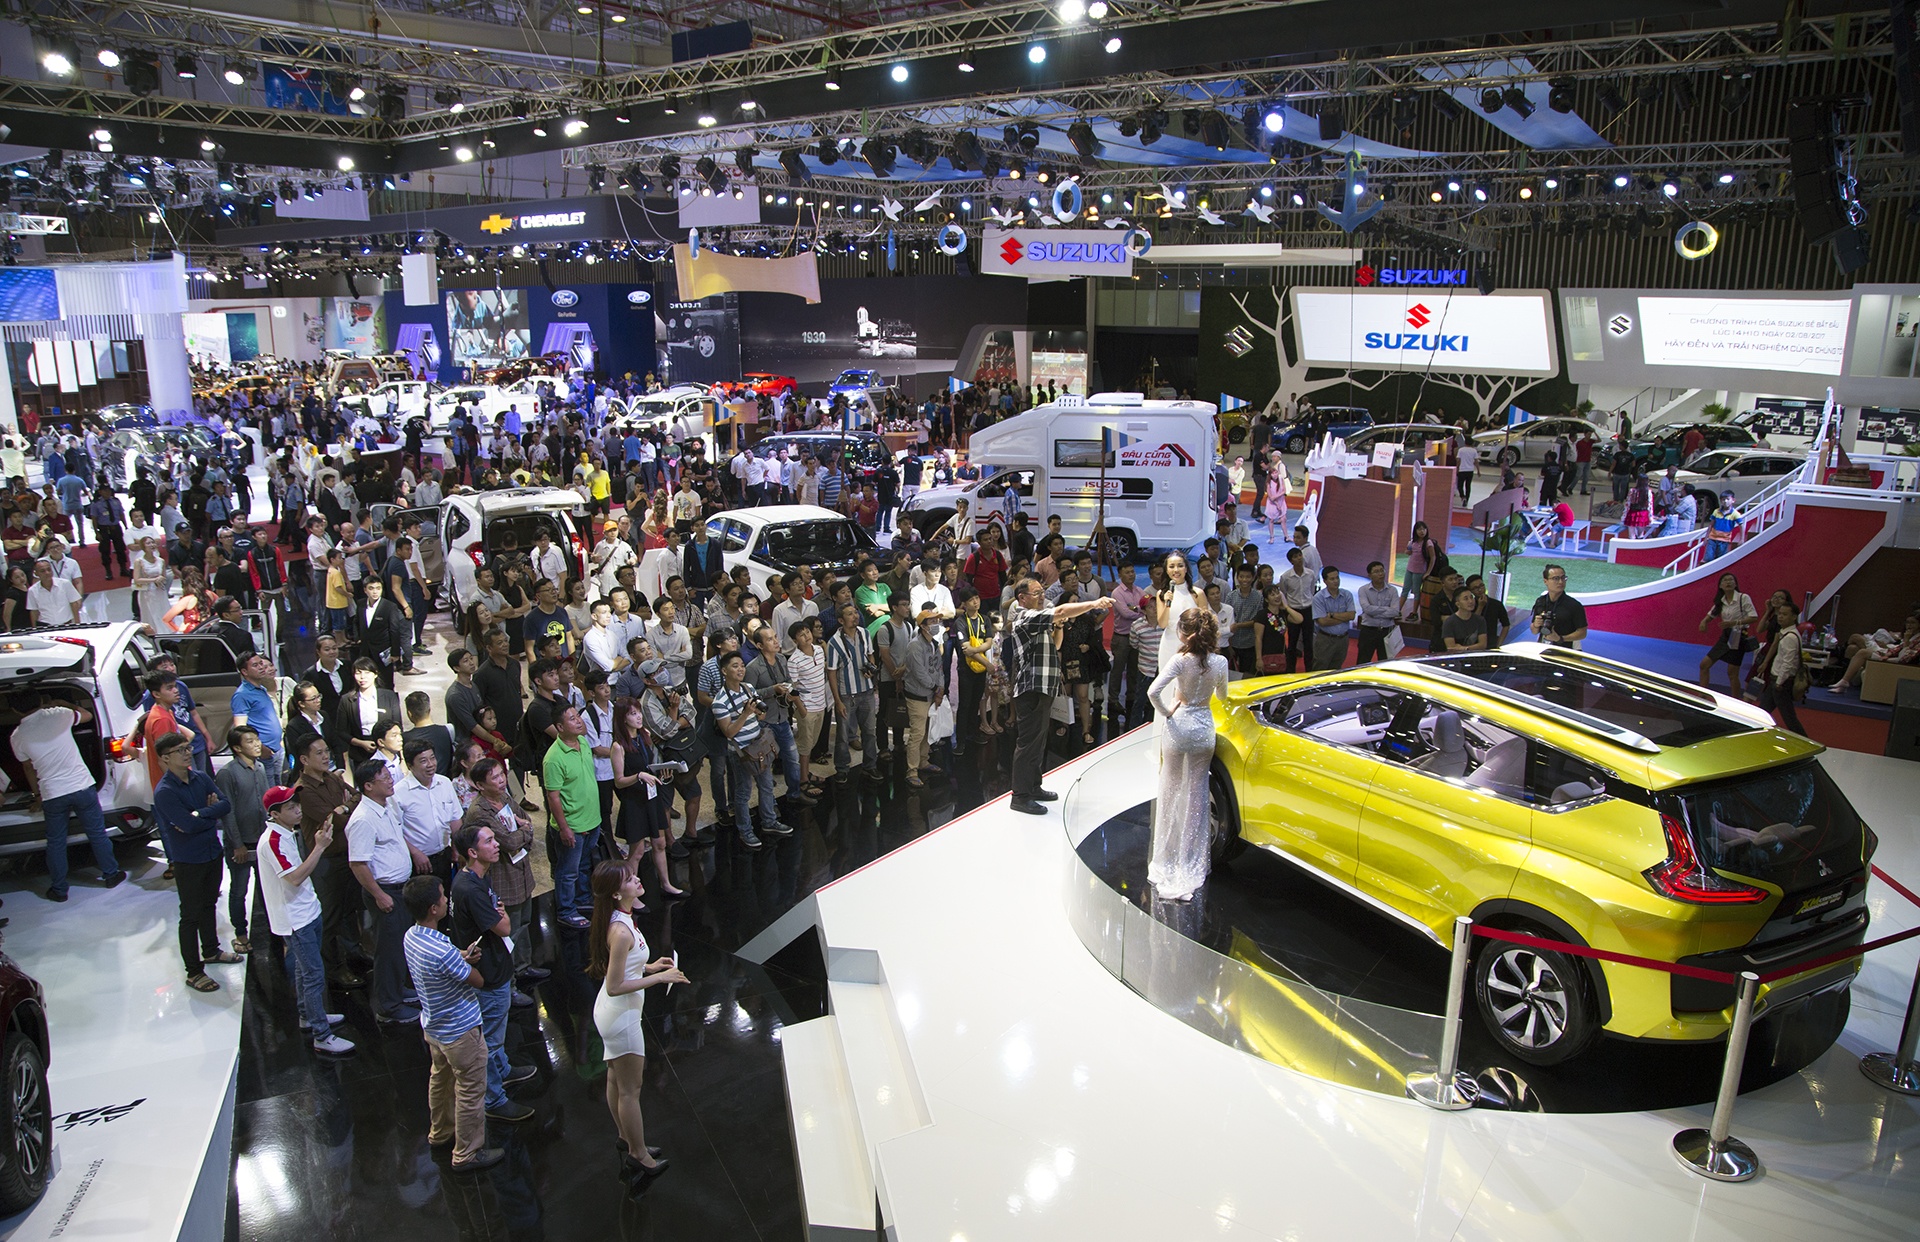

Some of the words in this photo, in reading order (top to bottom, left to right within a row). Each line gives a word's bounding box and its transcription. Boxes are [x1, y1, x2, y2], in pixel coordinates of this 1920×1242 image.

[520, 211, 587, 229] CHEVROLET
[1027, 241, 1127, 264] SUZUKI
[1379, 267, 1468, 285] SUZUKI
[1731, 317, 1757, 325] TRÌNH
[801, 331, 826, 344] 1930
[1364, 332, 1469, 352] SUZUKI
[1711, 341, 1725, 349] VÀ
[1121, 449, 1143, 459] ĐÂU
[1135, 459, 1149, 467] LÀ
